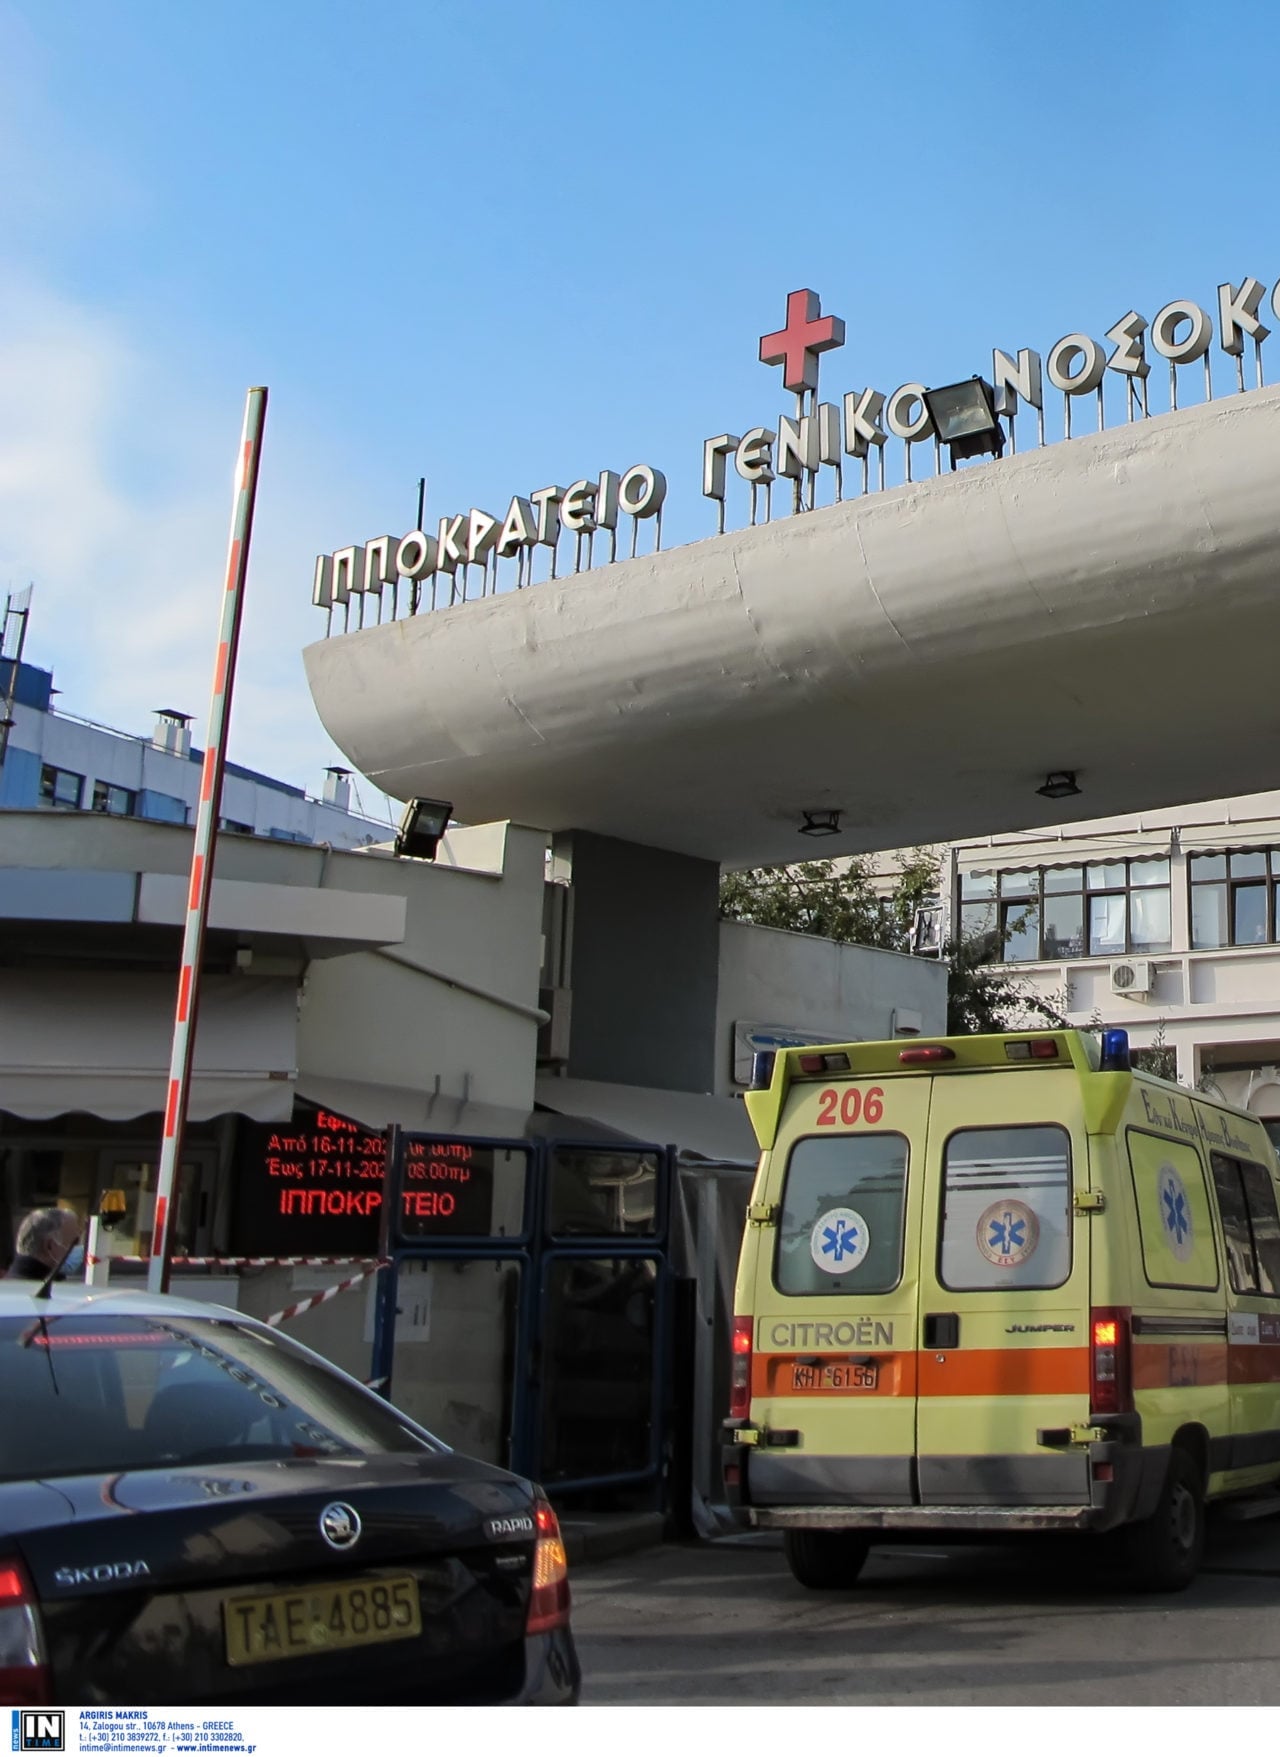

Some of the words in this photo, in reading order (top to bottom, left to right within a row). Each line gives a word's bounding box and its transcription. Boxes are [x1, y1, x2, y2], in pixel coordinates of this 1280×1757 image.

[312, 463, 668, 608] ΙΠΠΟΚΡΑΤΕΙΟ
[703, 382, 936, 500] ΓΕΝΙΚΟ
[817, 1086, 884, 1126] 206
[268, 1134, 306, 1152] Από
[280, 1190, 455, 1216] ΙΠΠΟΚΡΤΕΙΟ
[771, 1317, 894, 1348] CITROËN
[1005, 1323, 1075, 1334] JUMPER
[491, 1517, 533, 1535] RAPID
